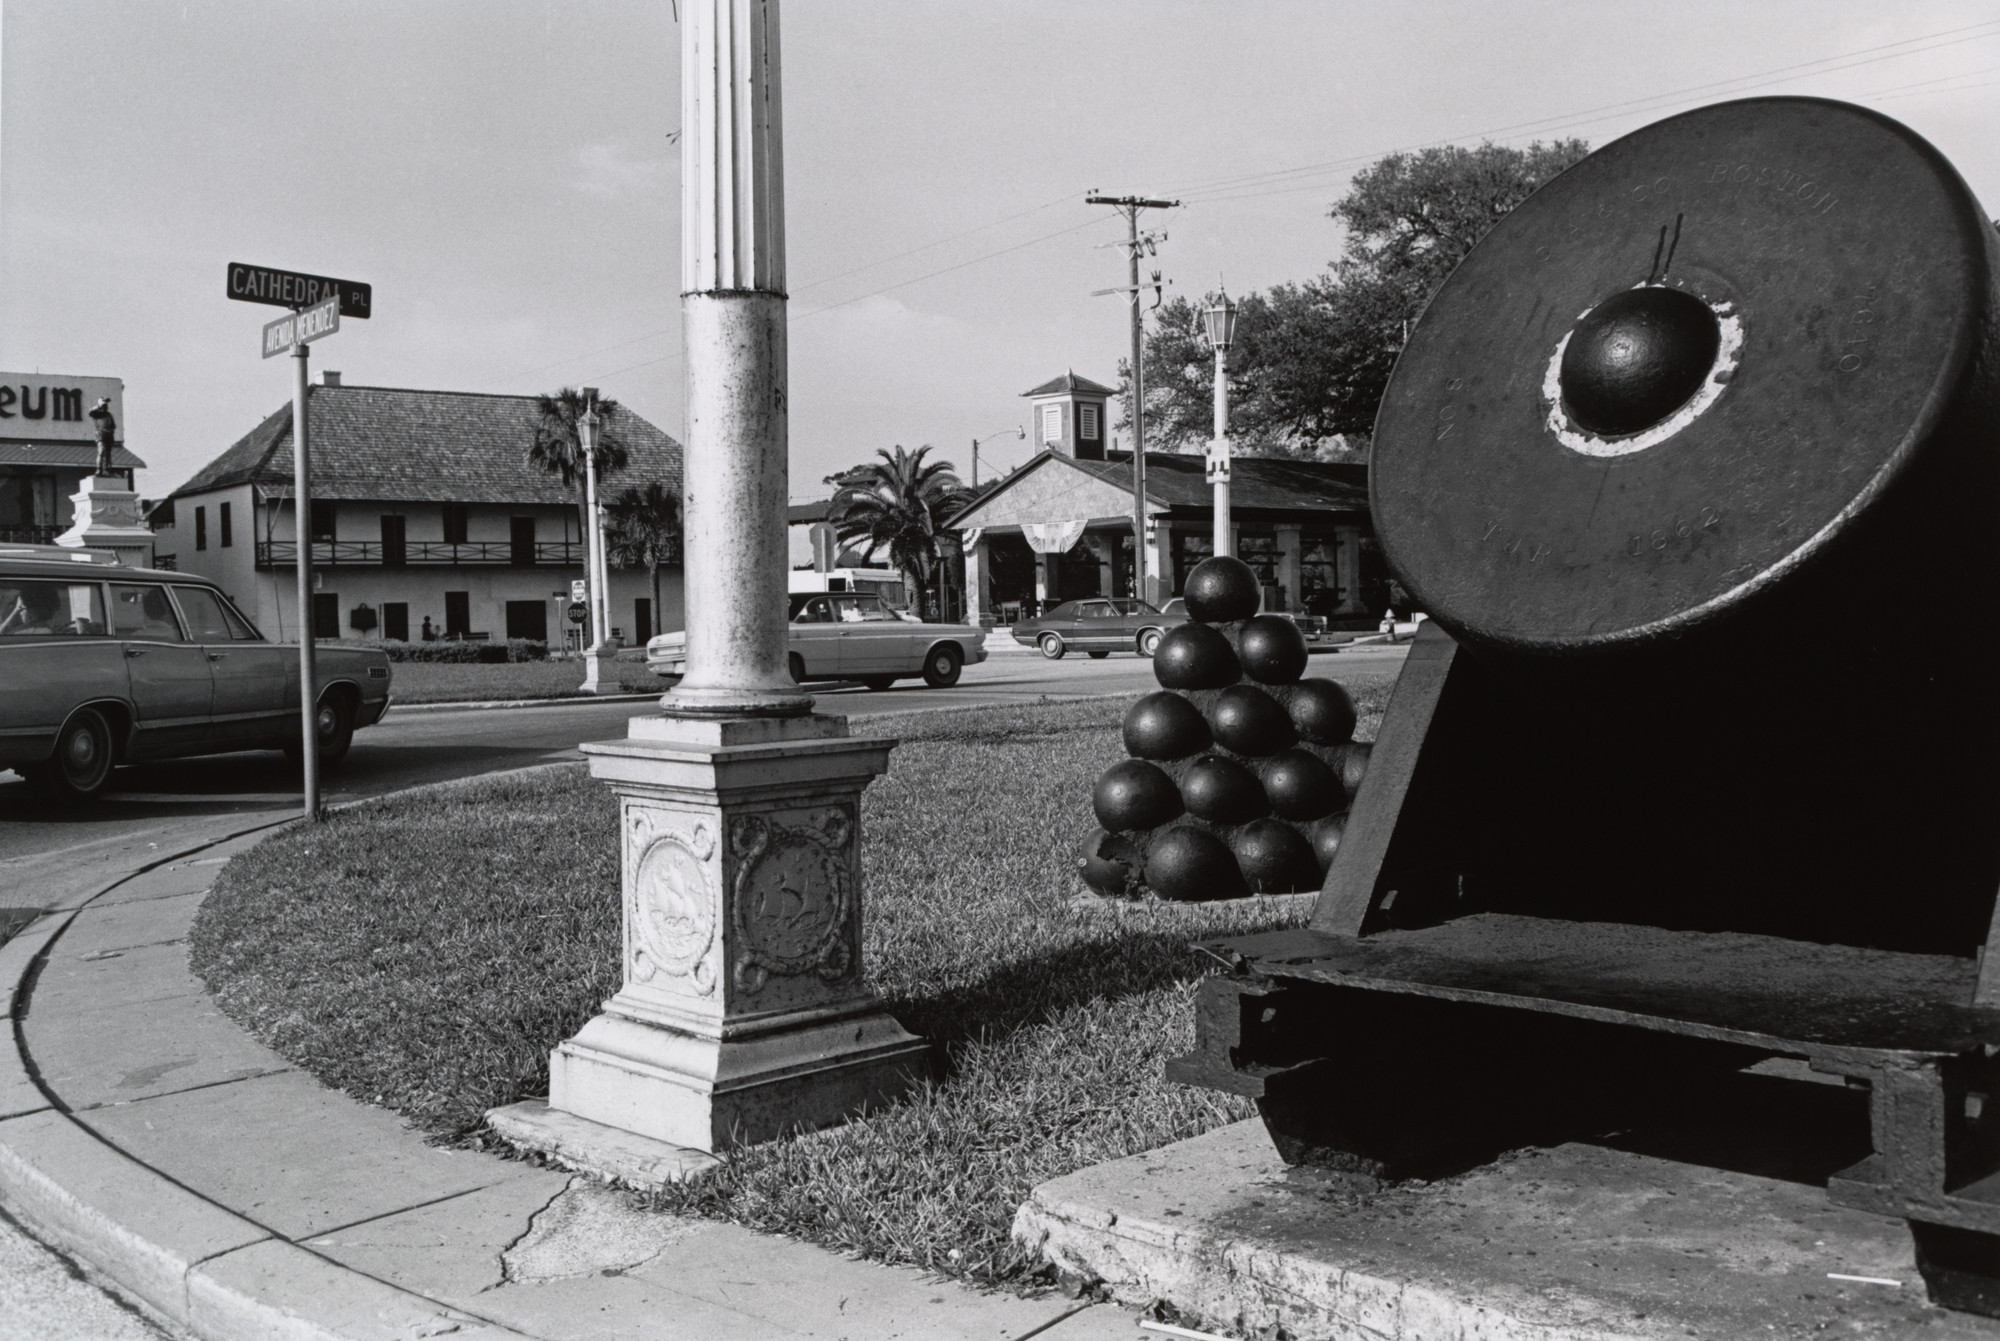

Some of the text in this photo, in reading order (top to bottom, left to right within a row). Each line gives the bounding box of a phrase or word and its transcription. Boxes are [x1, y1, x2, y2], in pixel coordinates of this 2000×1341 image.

[1708, 164, 1839, 214] BOSTON
[352, 292, 367, 306] PL
[265, 302, 335, 354] AVENIDA MENENDEZ
[1632, 506, 1720, 556] 1862
[569, 608, 587, 618] STOP
